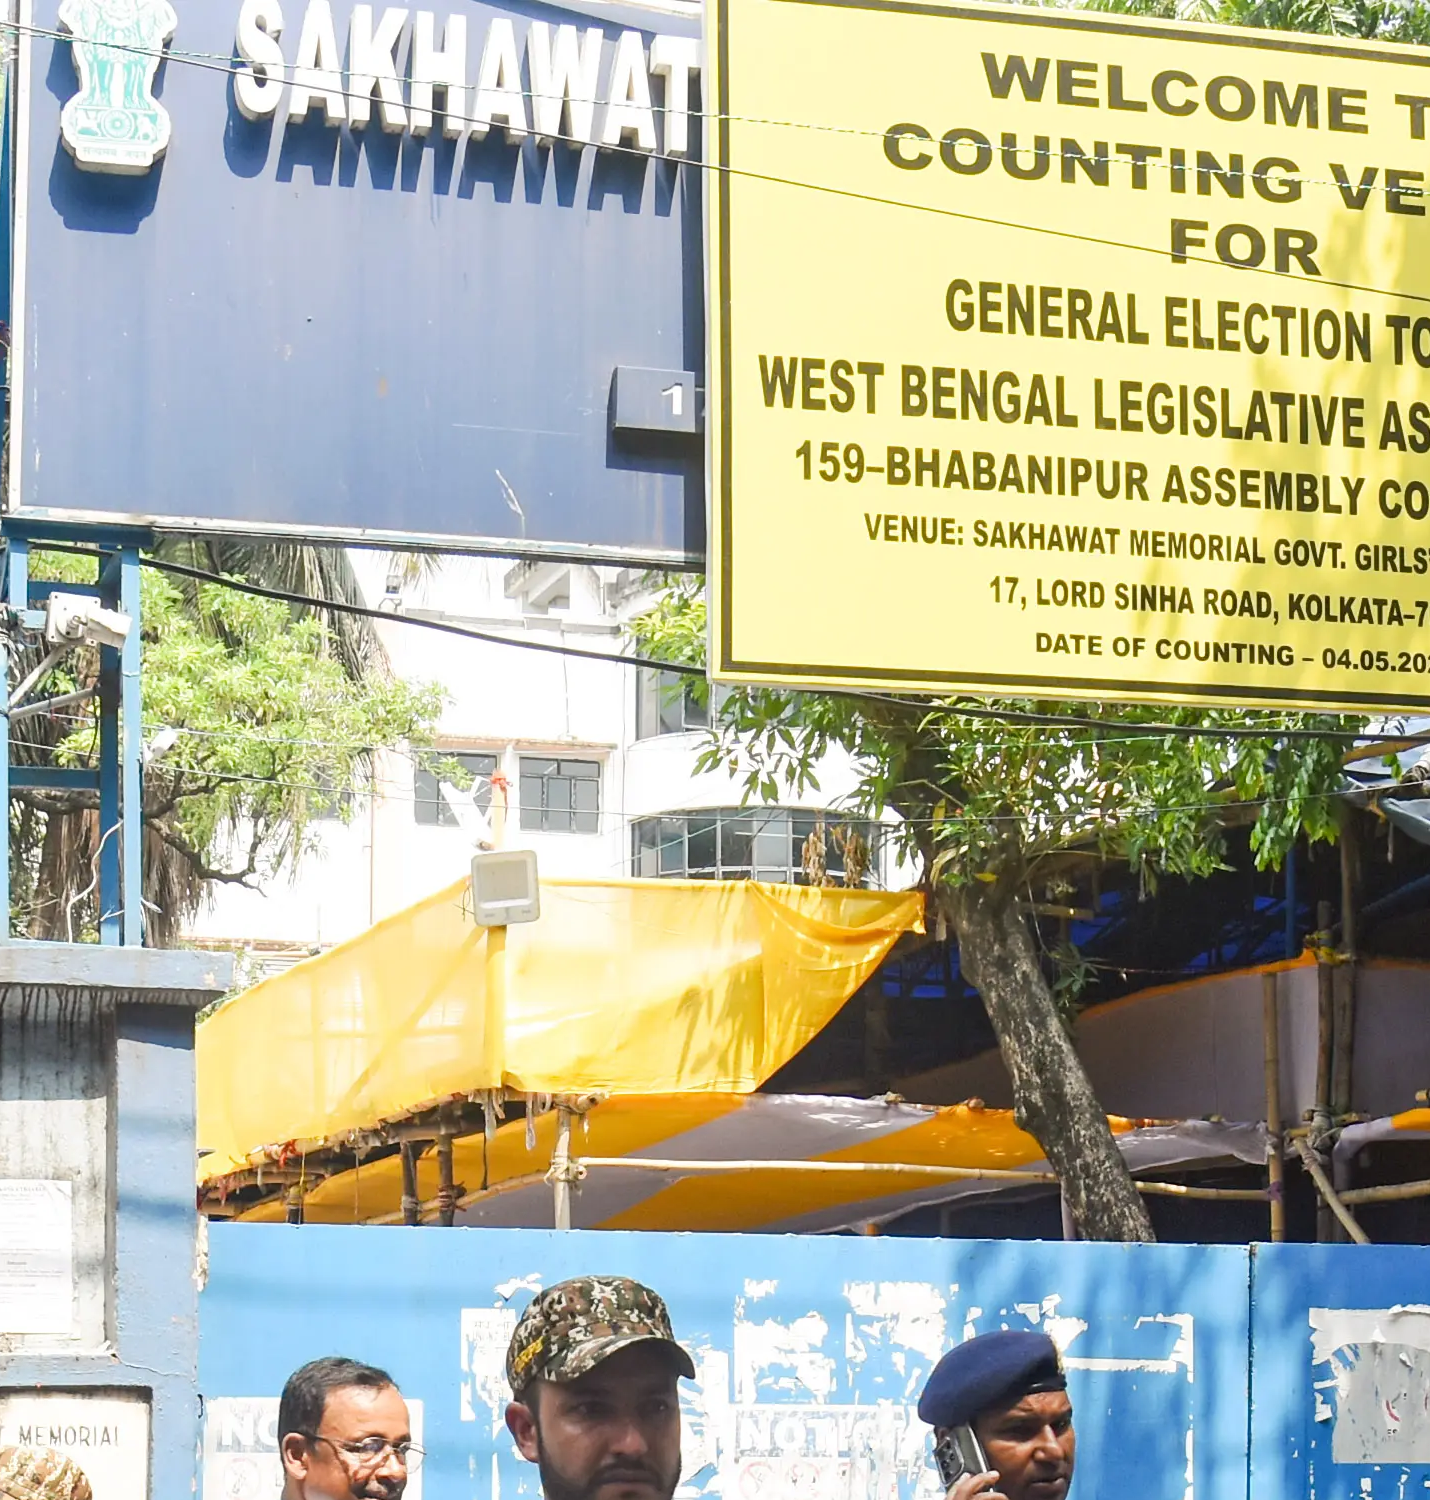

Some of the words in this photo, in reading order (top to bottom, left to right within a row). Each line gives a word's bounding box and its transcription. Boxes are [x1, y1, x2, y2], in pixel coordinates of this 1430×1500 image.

[234, 0, 702, 156] SAKHAWAT
[980, 52, 1369, 134] WELCOME
[883, 123, 1303, 203] COUNTING
[1170, 218, 1322, 276] FOR
[946, 278, 1149, 345] GENERAL
[1165, 296, 1371, 363] ELECTION
[759, 354, 884, 414] WEST
[902, 364, 1078, 427] BENGAL
[1094, 378, 1365, 448] LEGISLATIVE
[1163, 465, 1365, 516] ASSEMBLY
[864, 513, 964, 546] VENUE:
[973, 520, 1120, 555] SAKHAWAT
[1130, 529, 1266, 564] MEMORIAL
[1274, 539, 1347, 570] GOVT.
[989, 576, 1028, 611] 17,
[1036, 578, 1105, 609] LORD
[1114, 583, 1194, 614] SINHA
[1204, 588, 1279, 625] ROAD,
[1035, 632, 1102, 656] DATE
[1112, 637, 1146, 657] OF
[1155, 639, 1294, 666] COUNTING
